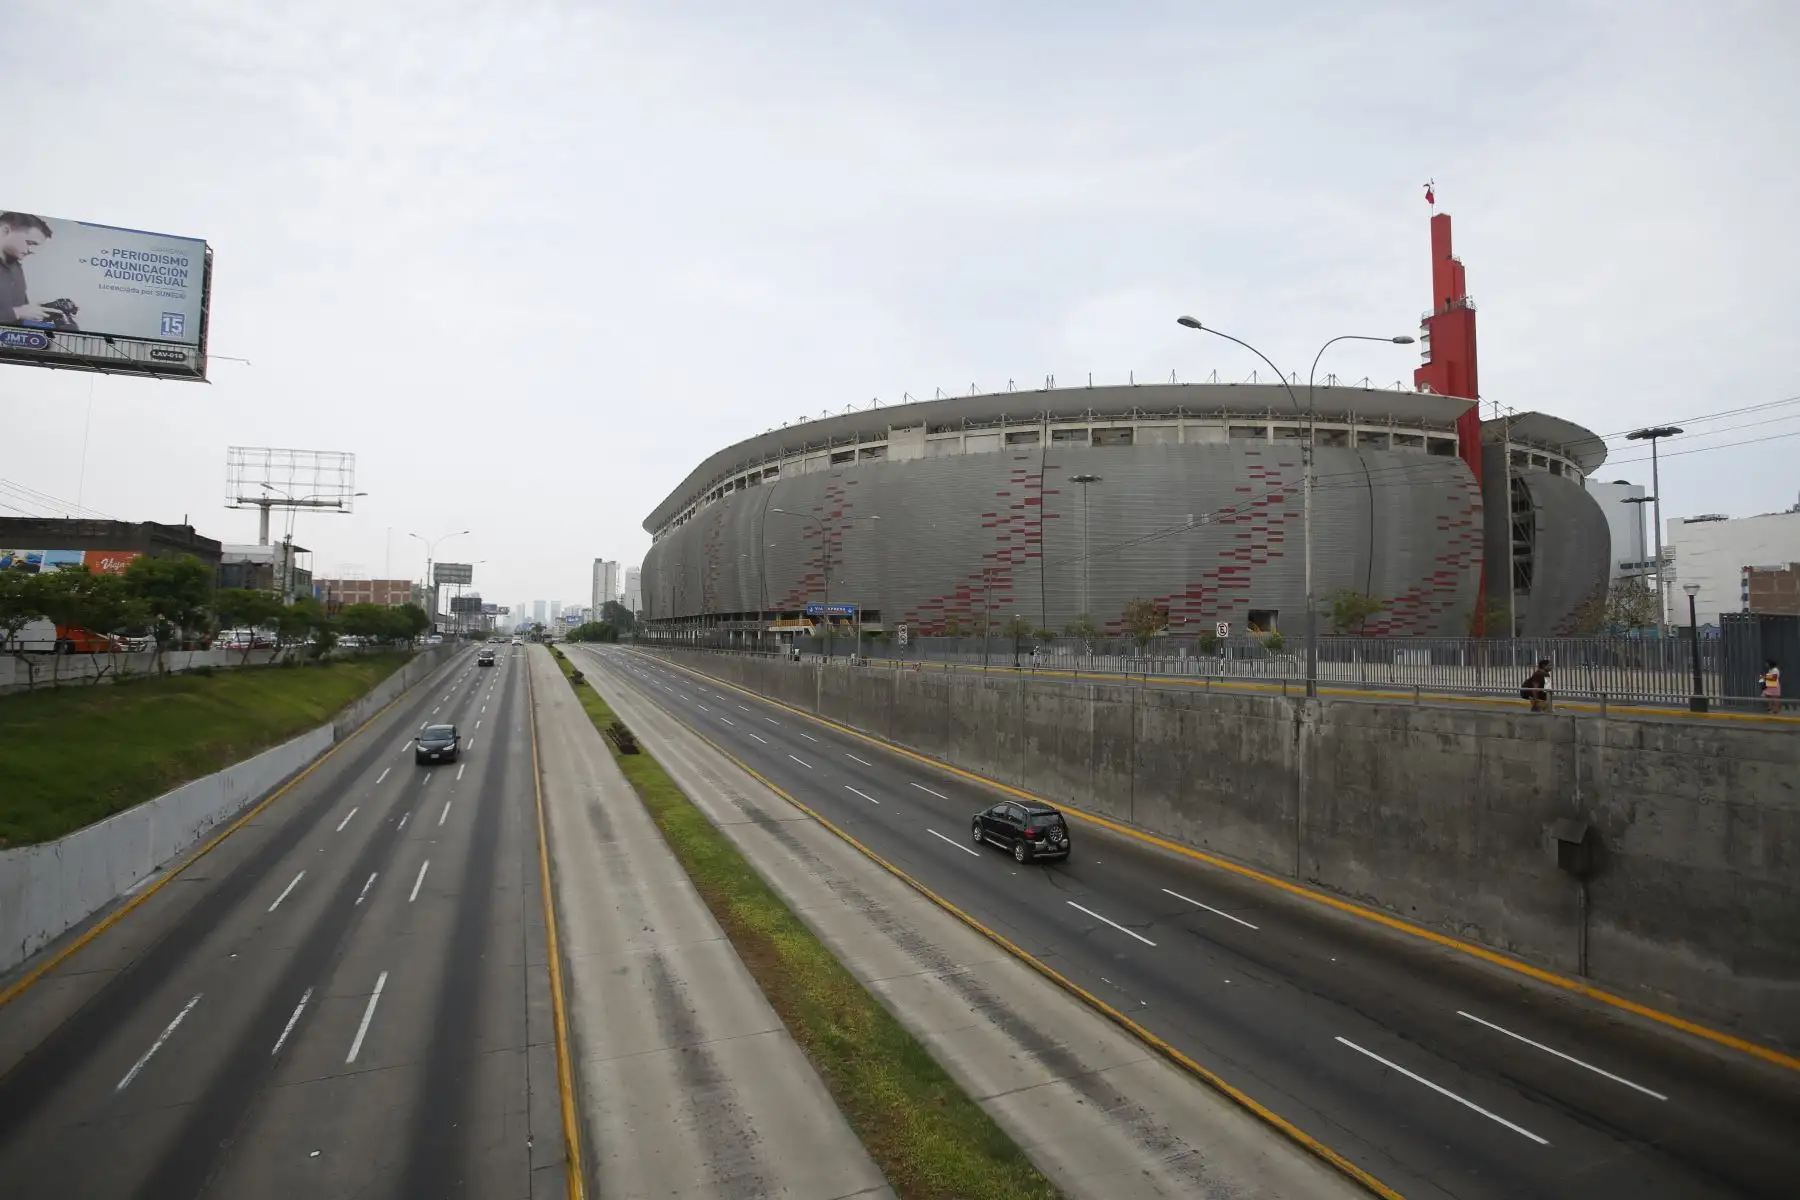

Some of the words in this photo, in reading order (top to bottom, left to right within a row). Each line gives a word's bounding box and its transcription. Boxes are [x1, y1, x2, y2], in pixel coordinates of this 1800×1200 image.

[112, 248, 189, 268] PERIODISMO
[90, 257, 188, 278] COMUNICACIÓN
[104, 269, 188, 288] AUDIOVISUAL
[98, 283, 140, 294] Licenciada
[155, 290, 187, 300] SUNEDU
[162, 317, 183, 333] 15
[5, 333, 28, 343] JMT
